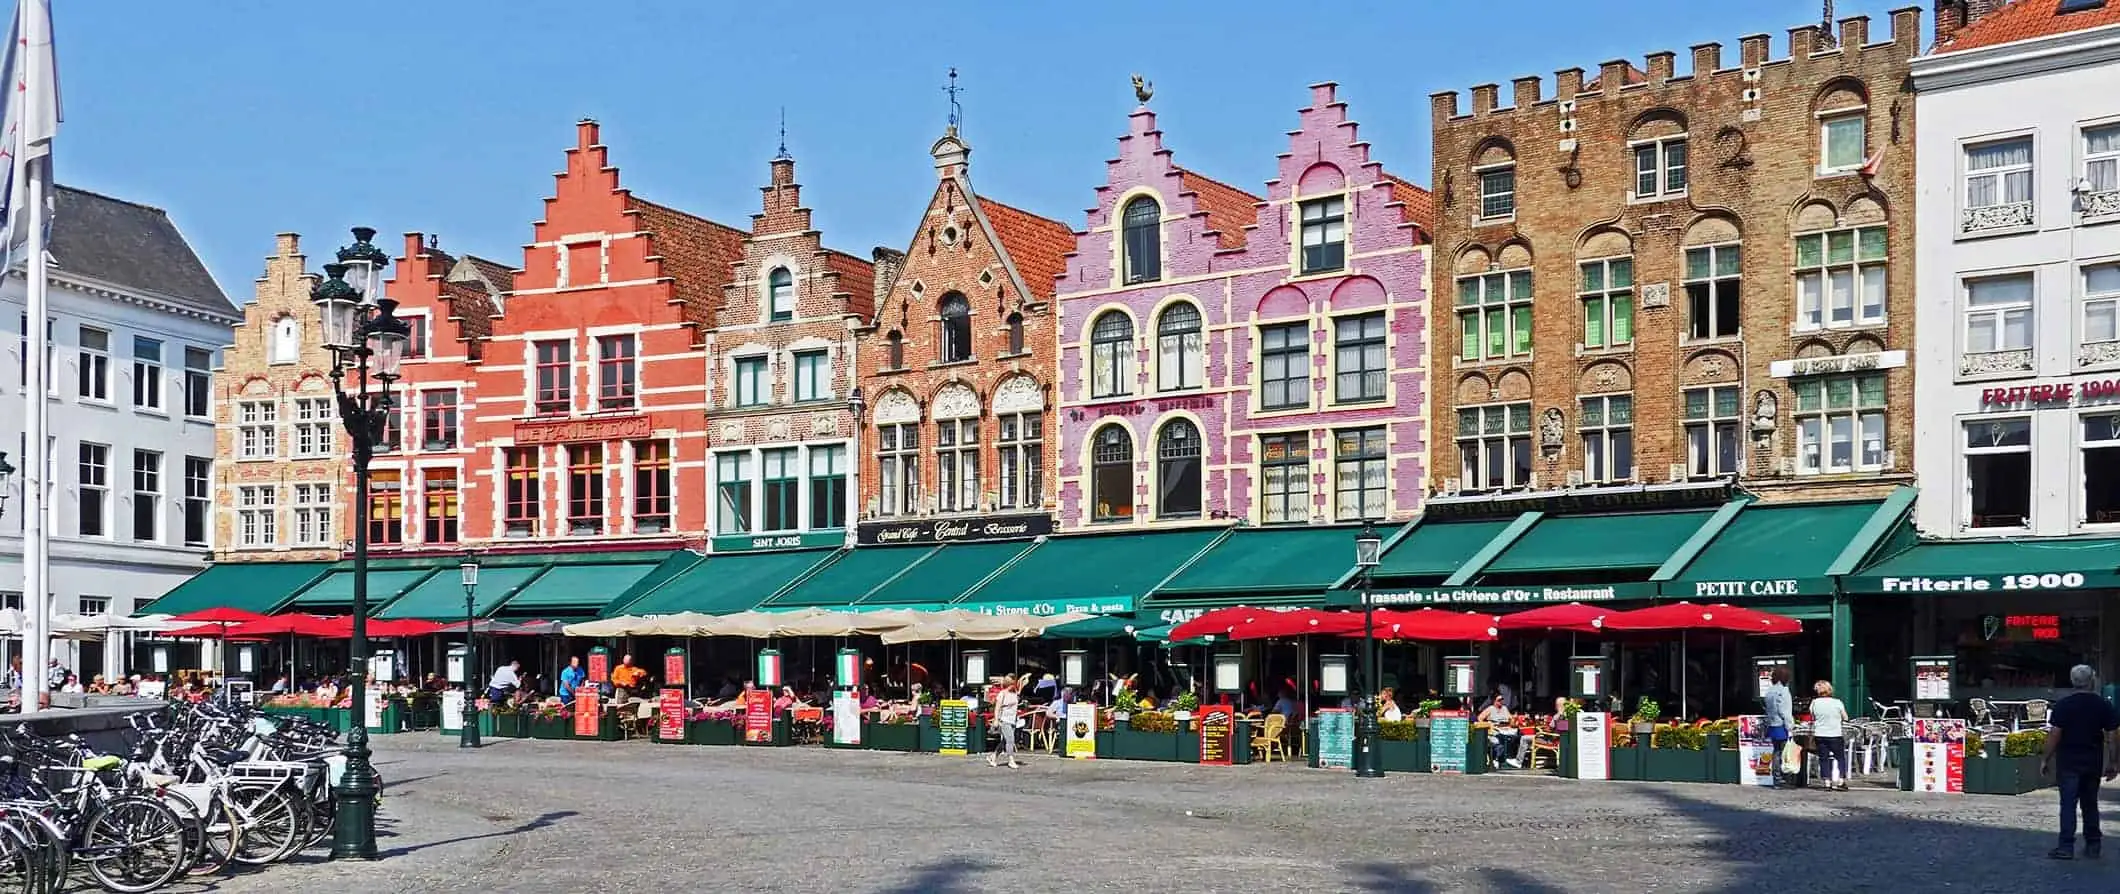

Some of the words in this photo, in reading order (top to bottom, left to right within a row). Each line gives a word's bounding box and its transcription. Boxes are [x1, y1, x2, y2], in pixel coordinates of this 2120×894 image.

[1982, 384, 2073, 405] FRITERIE
[542, 421, 603, 440] PANIER
[934, 519, 969, 541] Central
[984, 522, 1028, 534] Brasserie
[752, 538, 773, 548] SINT
[775, 536, 801, 546] JORIS
[1696, 581, 1746, 596] PETIT
[1750, 580, 1798, 595] CAFE
[1882, 577, 1990, 591] Friterie
[2002, 573, 2084, 590] 1900
[1433, 592, 1450, 602] La
[1502, 589, 1530, 601] d'Or
[1543, 587, 1615, 600] Restaurant
[1033, 603, 1055, 614] d'Or
[1066, 604, 1088, 613] Pizza
